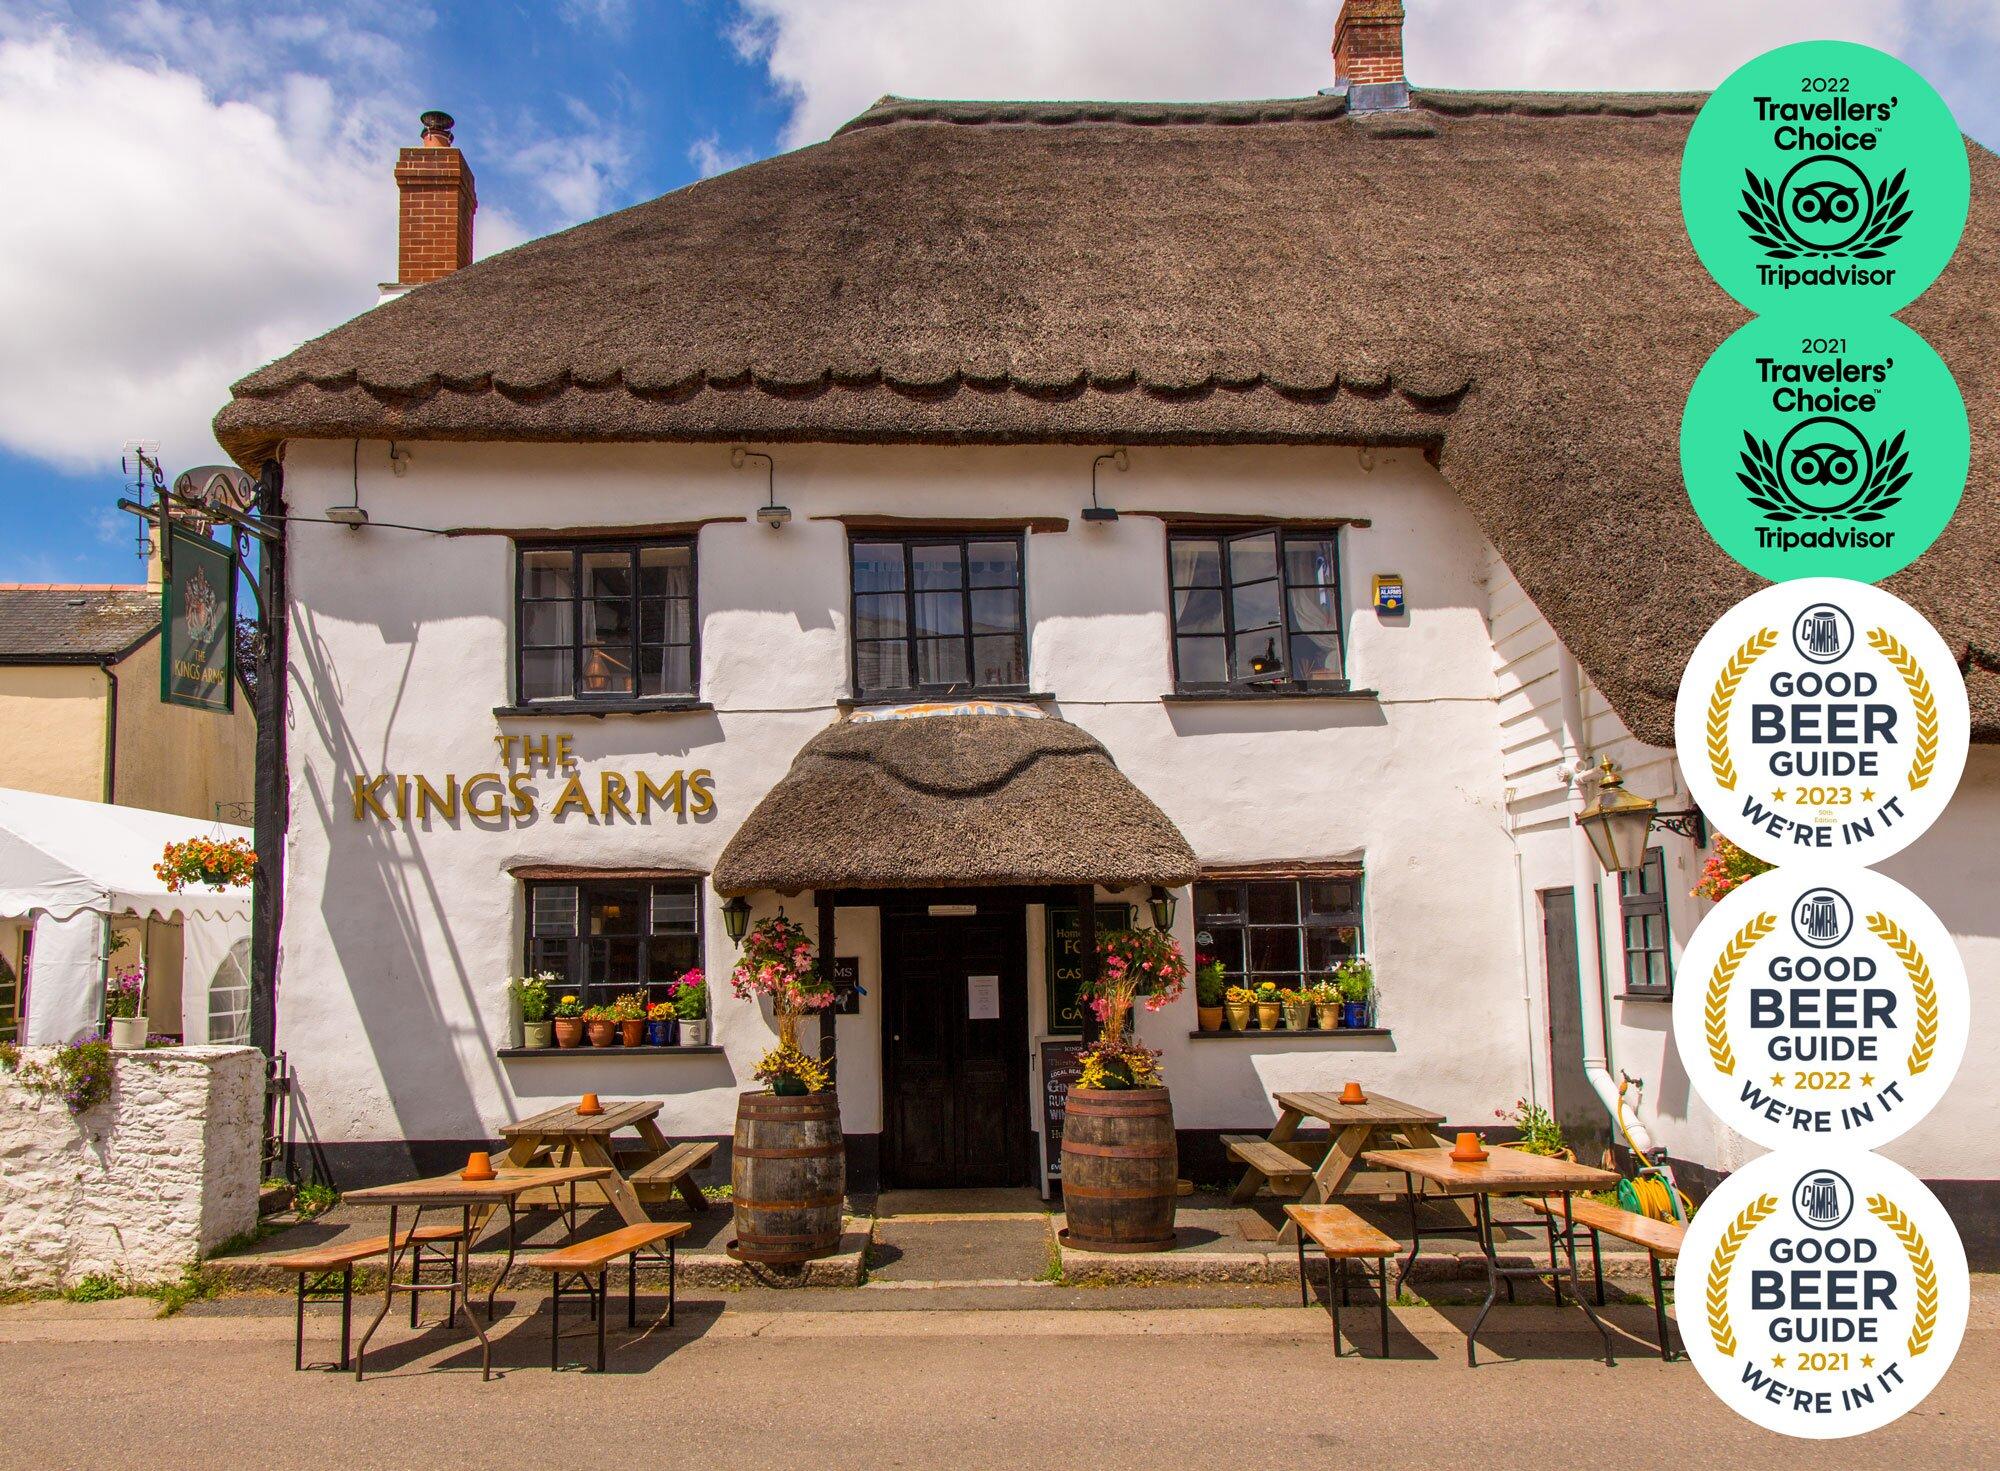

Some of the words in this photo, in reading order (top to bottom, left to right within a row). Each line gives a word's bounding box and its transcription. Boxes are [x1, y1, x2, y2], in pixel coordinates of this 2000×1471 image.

[195, 649, 206, 662] THE
[174, 659, 200, 680] KINGS
[201, 667, 224, 686] ARMS
[494, 734, 575, 766] THE
[353, 773, 535, 821] KINGS
[550, 769, 715, 817] ARMS
[1050, 1070, 1067, 1078] LOCAL
